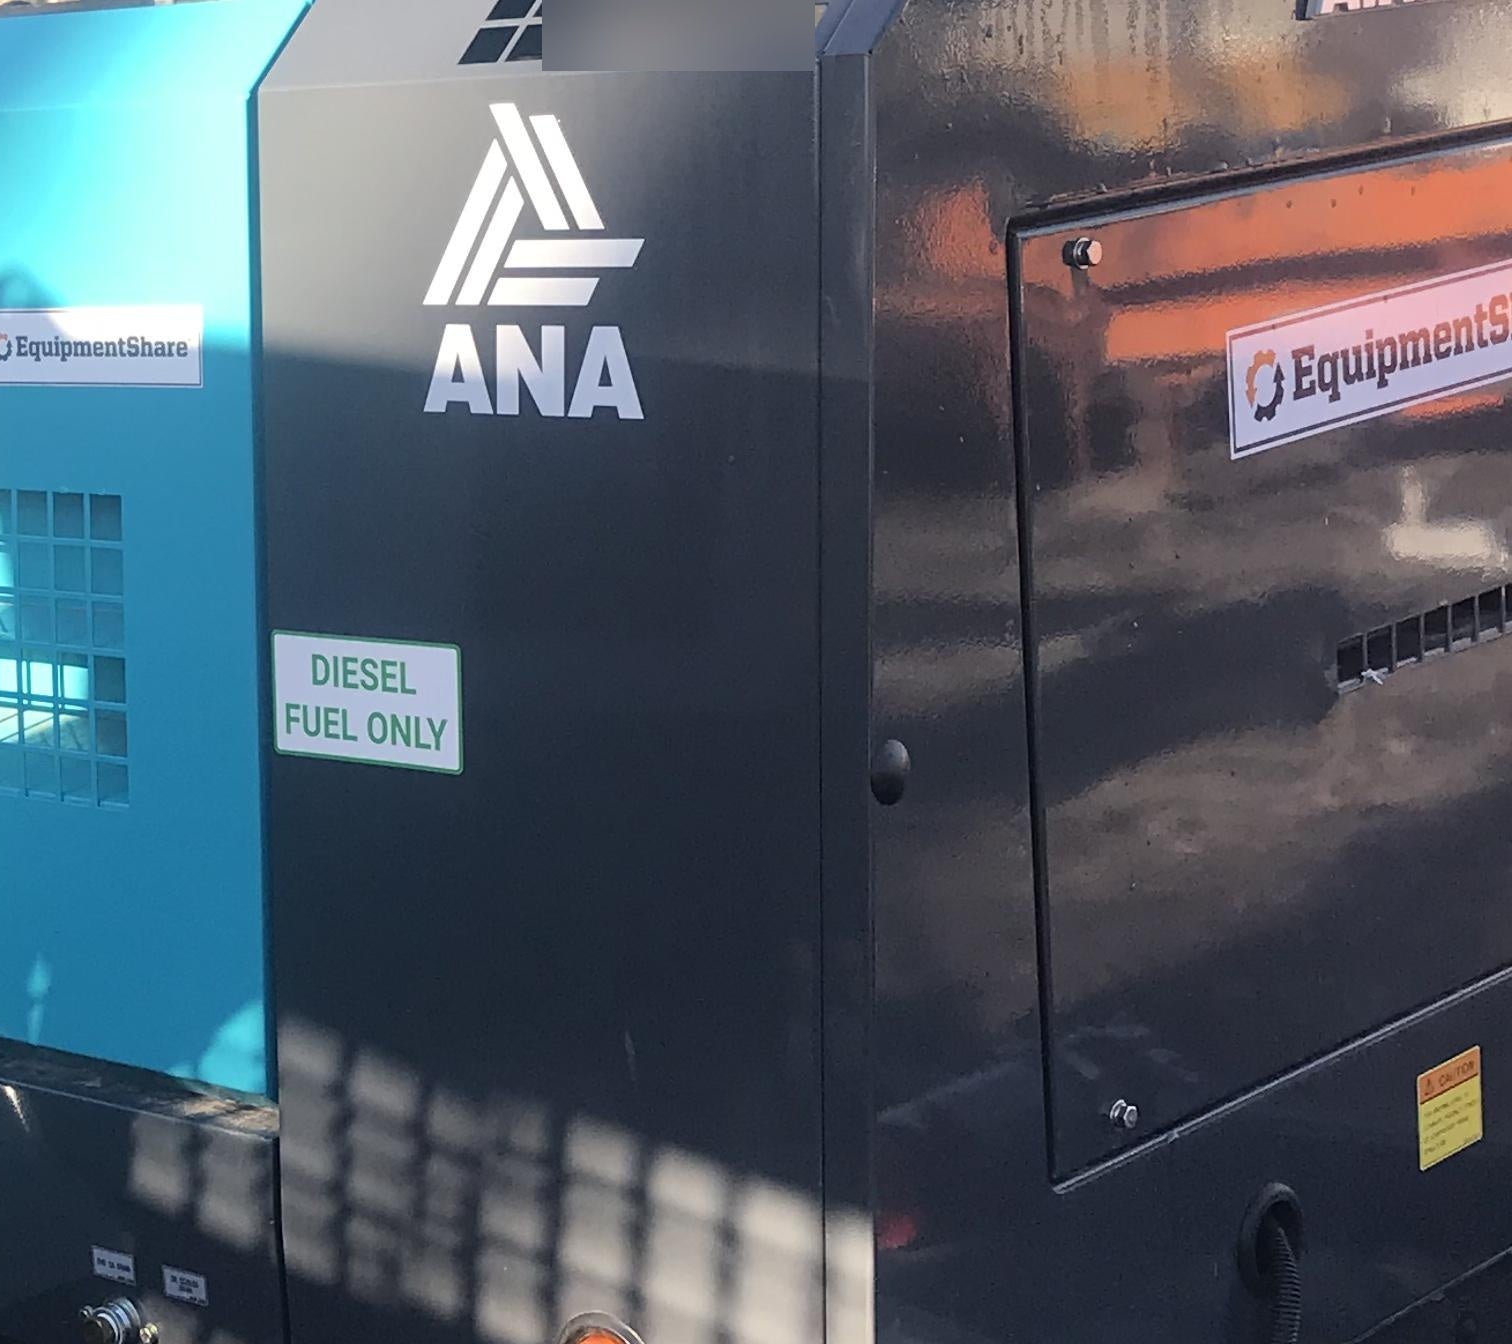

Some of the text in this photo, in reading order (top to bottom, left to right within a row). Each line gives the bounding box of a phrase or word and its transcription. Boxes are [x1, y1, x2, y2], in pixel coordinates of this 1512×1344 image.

[15, 334, 188, 362] EquipmentShare
[1291, 290, 1512, 403] EquipmentS
[423, 323, 644, 419] ANA
[311, 653, 417, 695] DIESEL
[285, 703, 448, 751] FUEL ONLY
